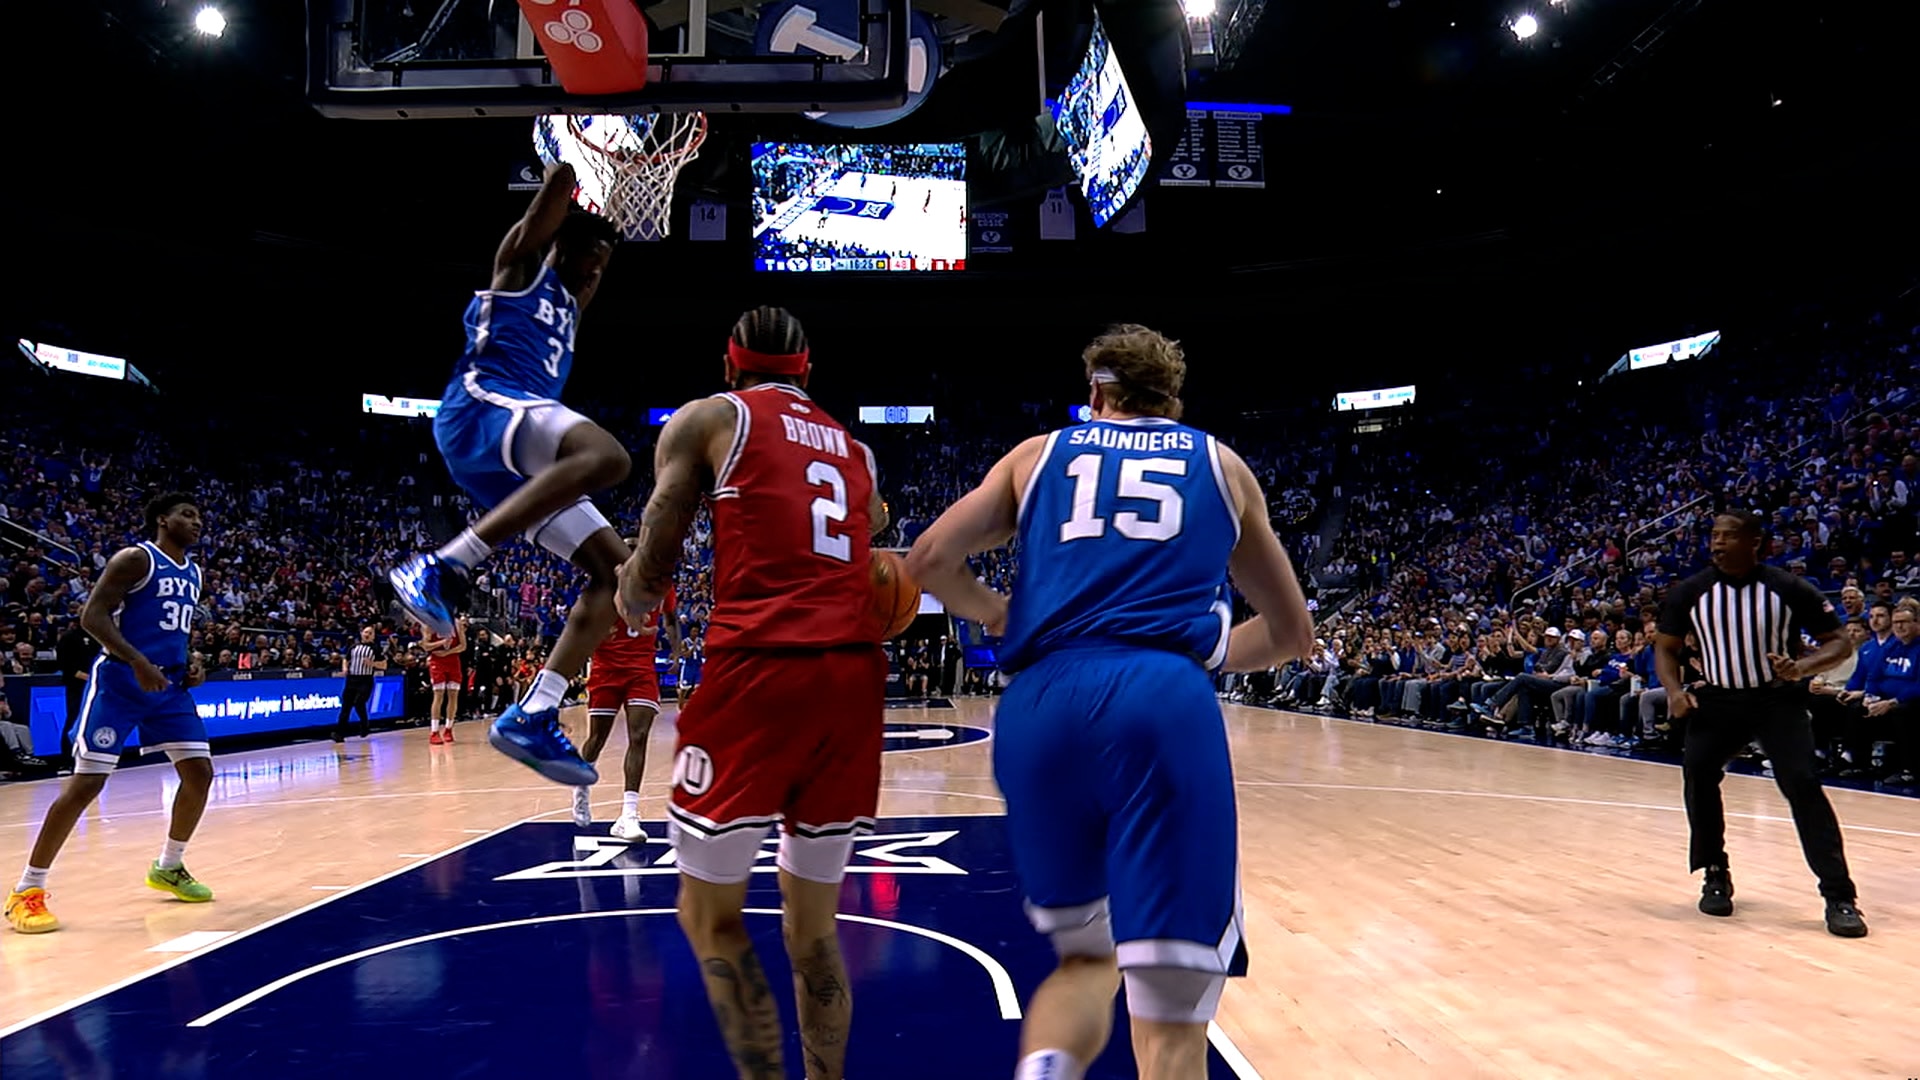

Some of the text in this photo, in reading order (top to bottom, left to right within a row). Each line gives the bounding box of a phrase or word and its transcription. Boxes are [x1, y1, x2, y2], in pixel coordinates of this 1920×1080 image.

[701, 207, 716, 221] 14
[1052, 202, 1062, 214] 11
[543, 337, 564, 378] 3
[780, 413, 849, 458] BROWN
[1069, 427, 1193, 452] SAUNDERS
[806, 461, 851, 563] 2
[1060, 453, 1187, 543] 15
[156, 577, 201, 605] BYU
[159, 600, 194, 635] 30
[217, 703, 226, 717] a
[226, 698, 247, 720] key
[247, 696, 281, 719] player
[282, 695, 293, 712] in
